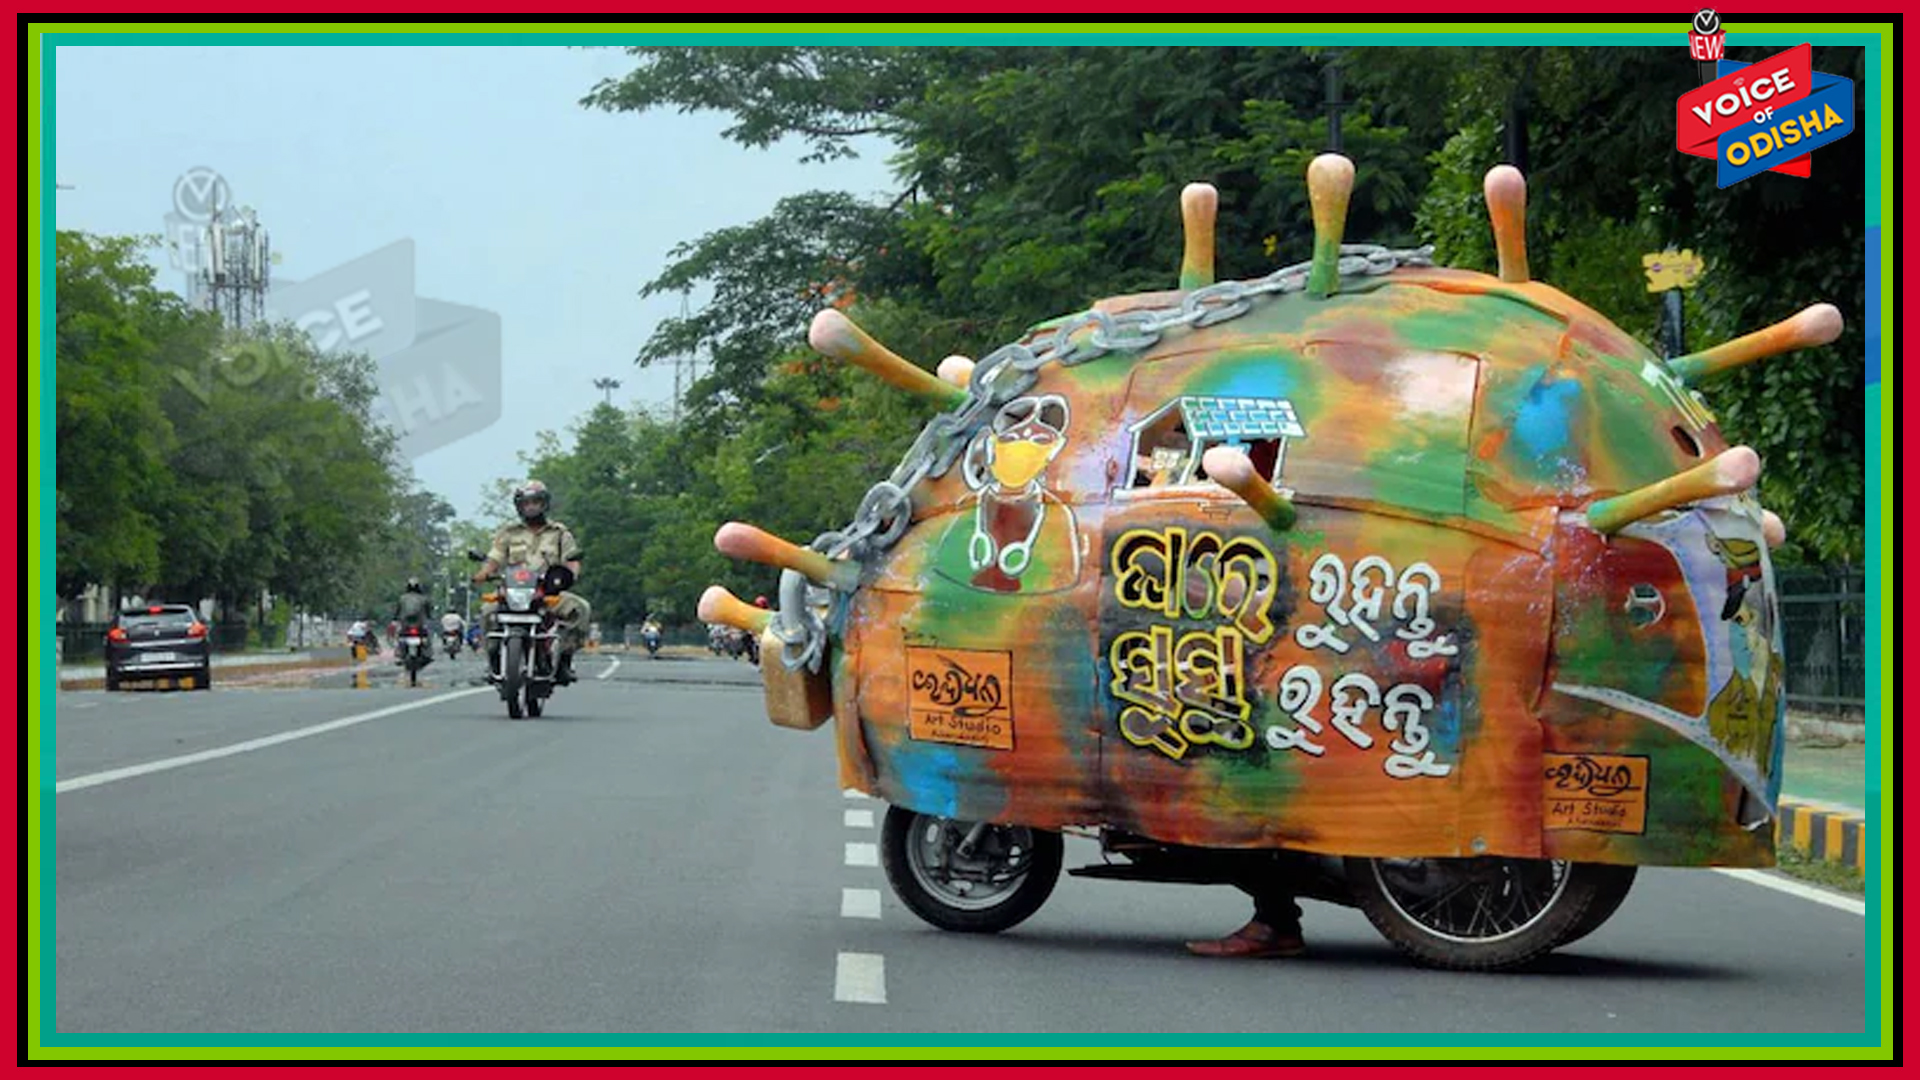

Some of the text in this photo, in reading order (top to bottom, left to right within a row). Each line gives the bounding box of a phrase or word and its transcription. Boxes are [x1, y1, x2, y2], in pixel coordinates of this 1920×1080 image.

[925, 714, 1002, 735] Art Studio
[1551, 801, 1575, 815] Art
